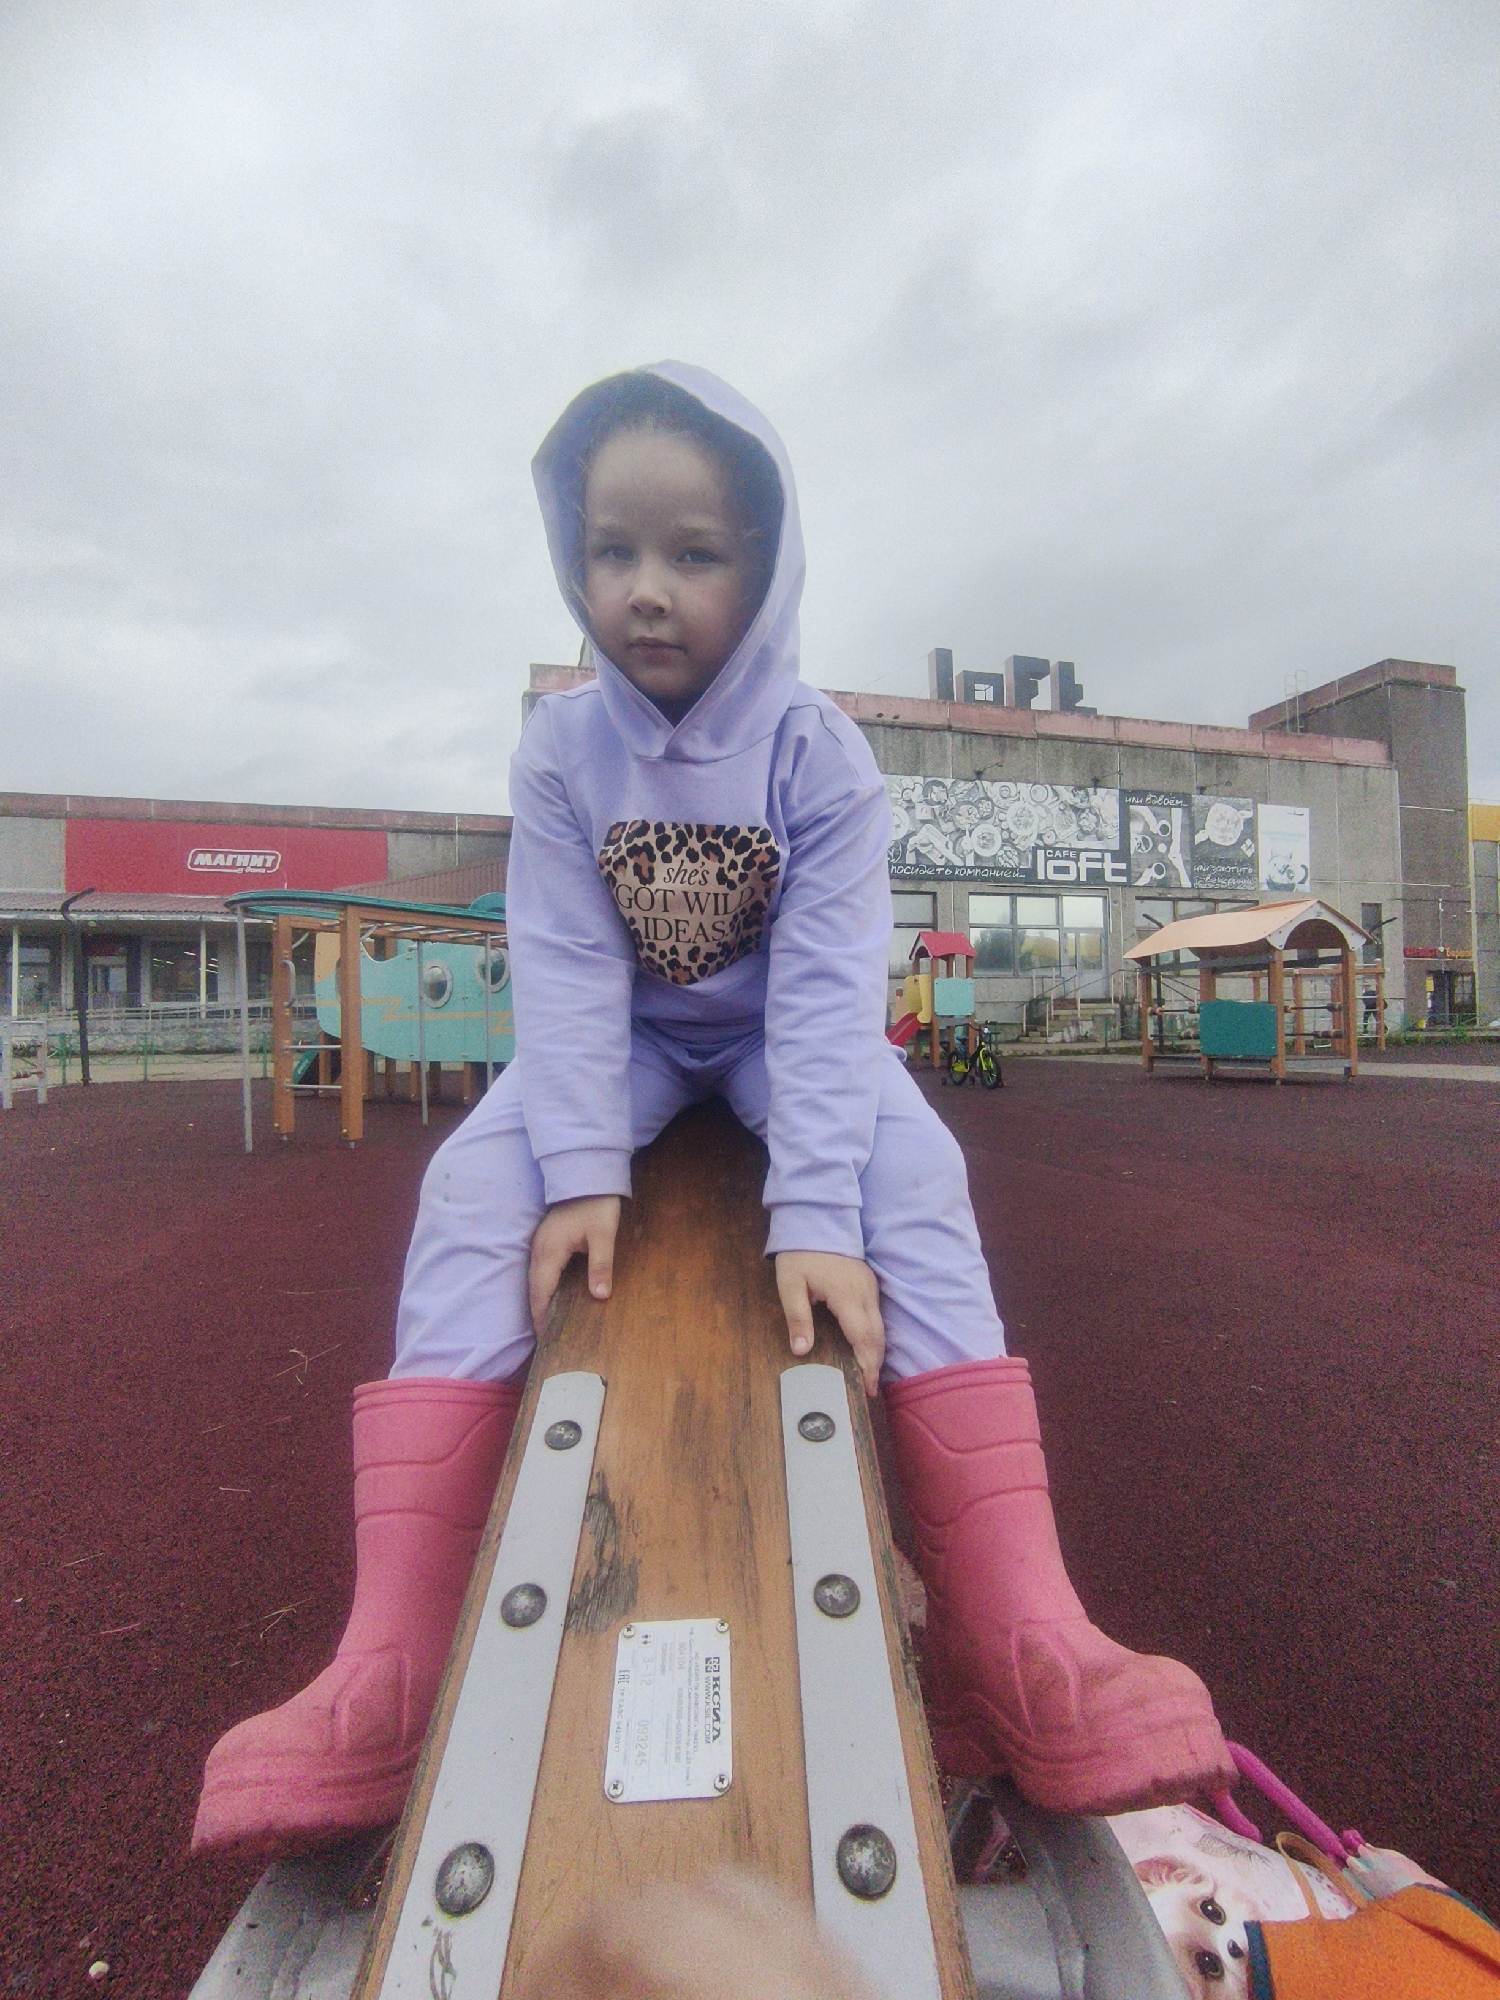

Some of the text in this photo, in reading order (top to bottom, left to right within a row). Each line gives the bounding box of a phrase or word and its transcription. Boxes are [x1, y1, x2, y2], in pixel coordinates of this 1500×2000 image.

[1125, 795, 1143, 804] или
[194, 853, 276, 867] МАГНИТ
[1046, 849, 1077, 858] CAFE
[663, 860, 710, 886] she's
[890, 864, 953, 875] посидеть
[1036, 849, 1127, 883] loft
[615, 884, 755, 916] GOT WILD
[635, 1720, 649, 1766] 093245
